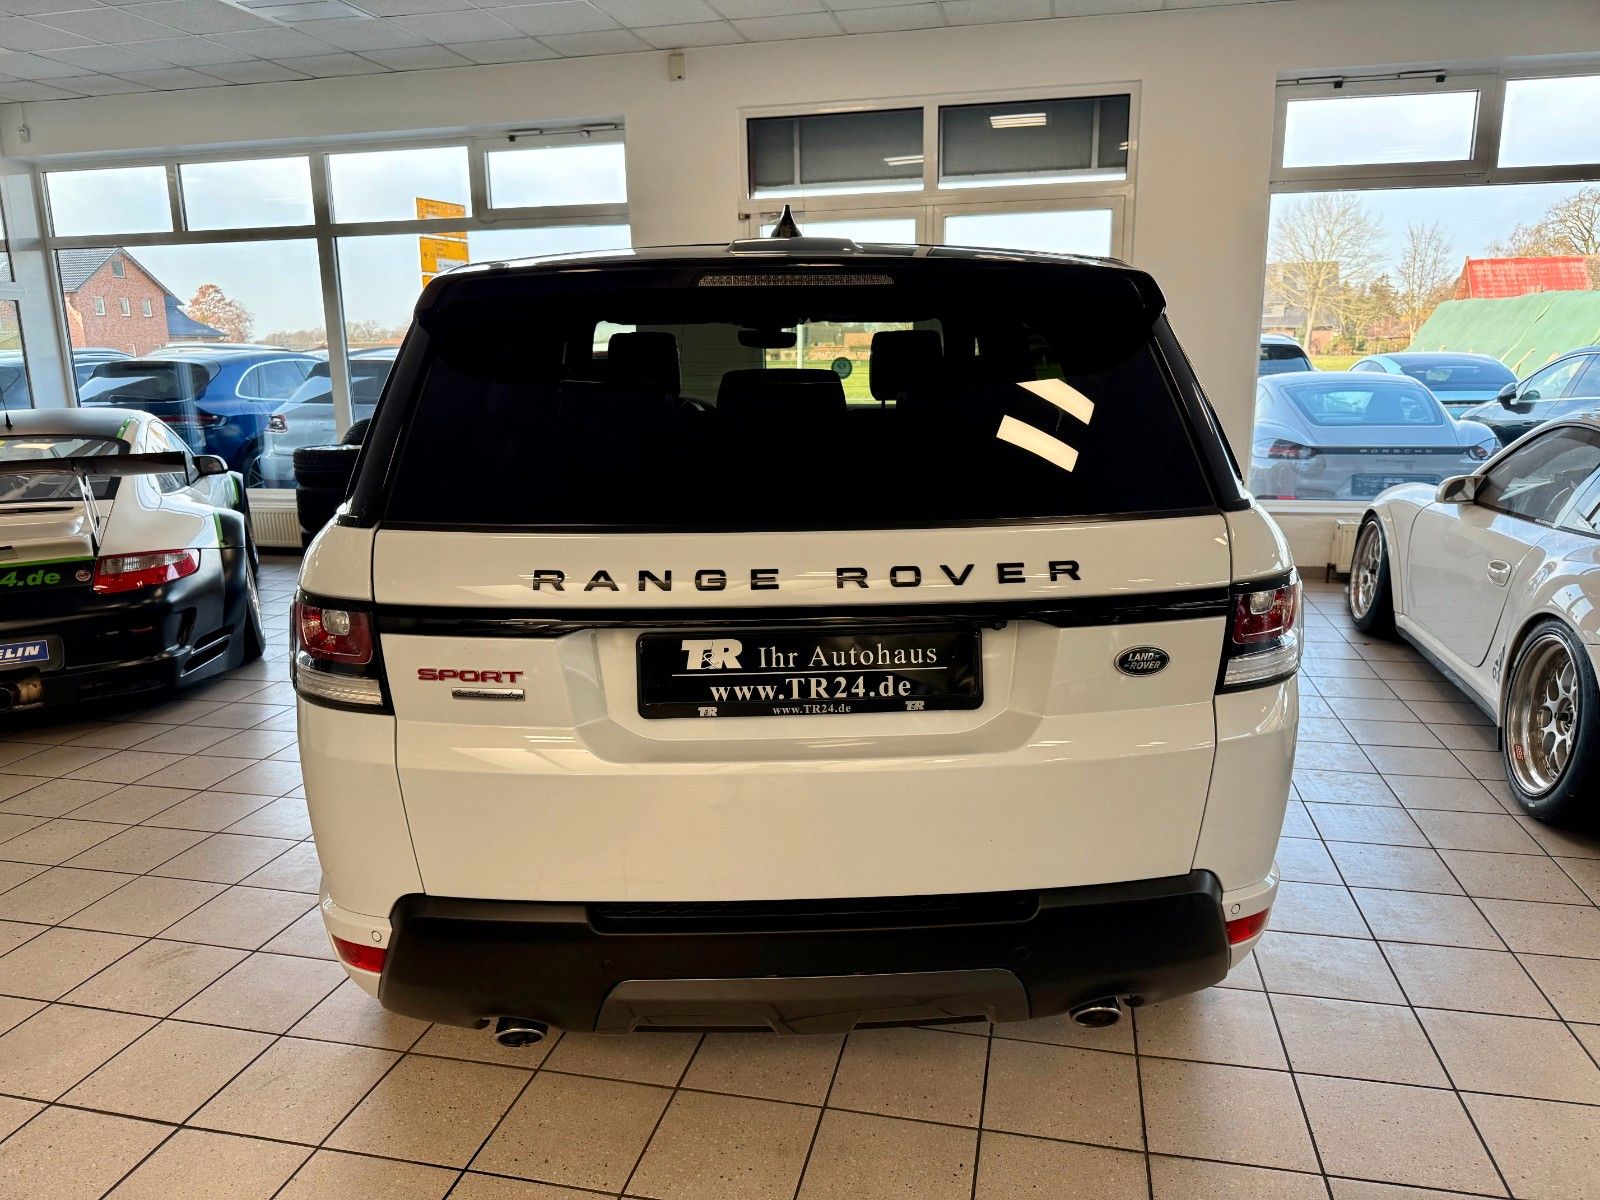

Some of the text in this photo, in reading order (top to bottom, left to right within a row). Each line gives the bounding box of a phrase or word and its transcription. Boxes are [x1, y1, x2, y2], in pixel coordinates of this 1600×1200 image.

[532, 560, 1082, 592] RANGE ROVER
[681, 638, 938, 670] T&R Ihr Autohaus
[1128, 652, 1154, 661] LAND
[1129, 661, 1161, 669] ROVER
[417, 668, 524, 684] SPORT
[709, 675, 911, 702] www.TR24.de
[772, 703, 852, 715] www.TR24.de
